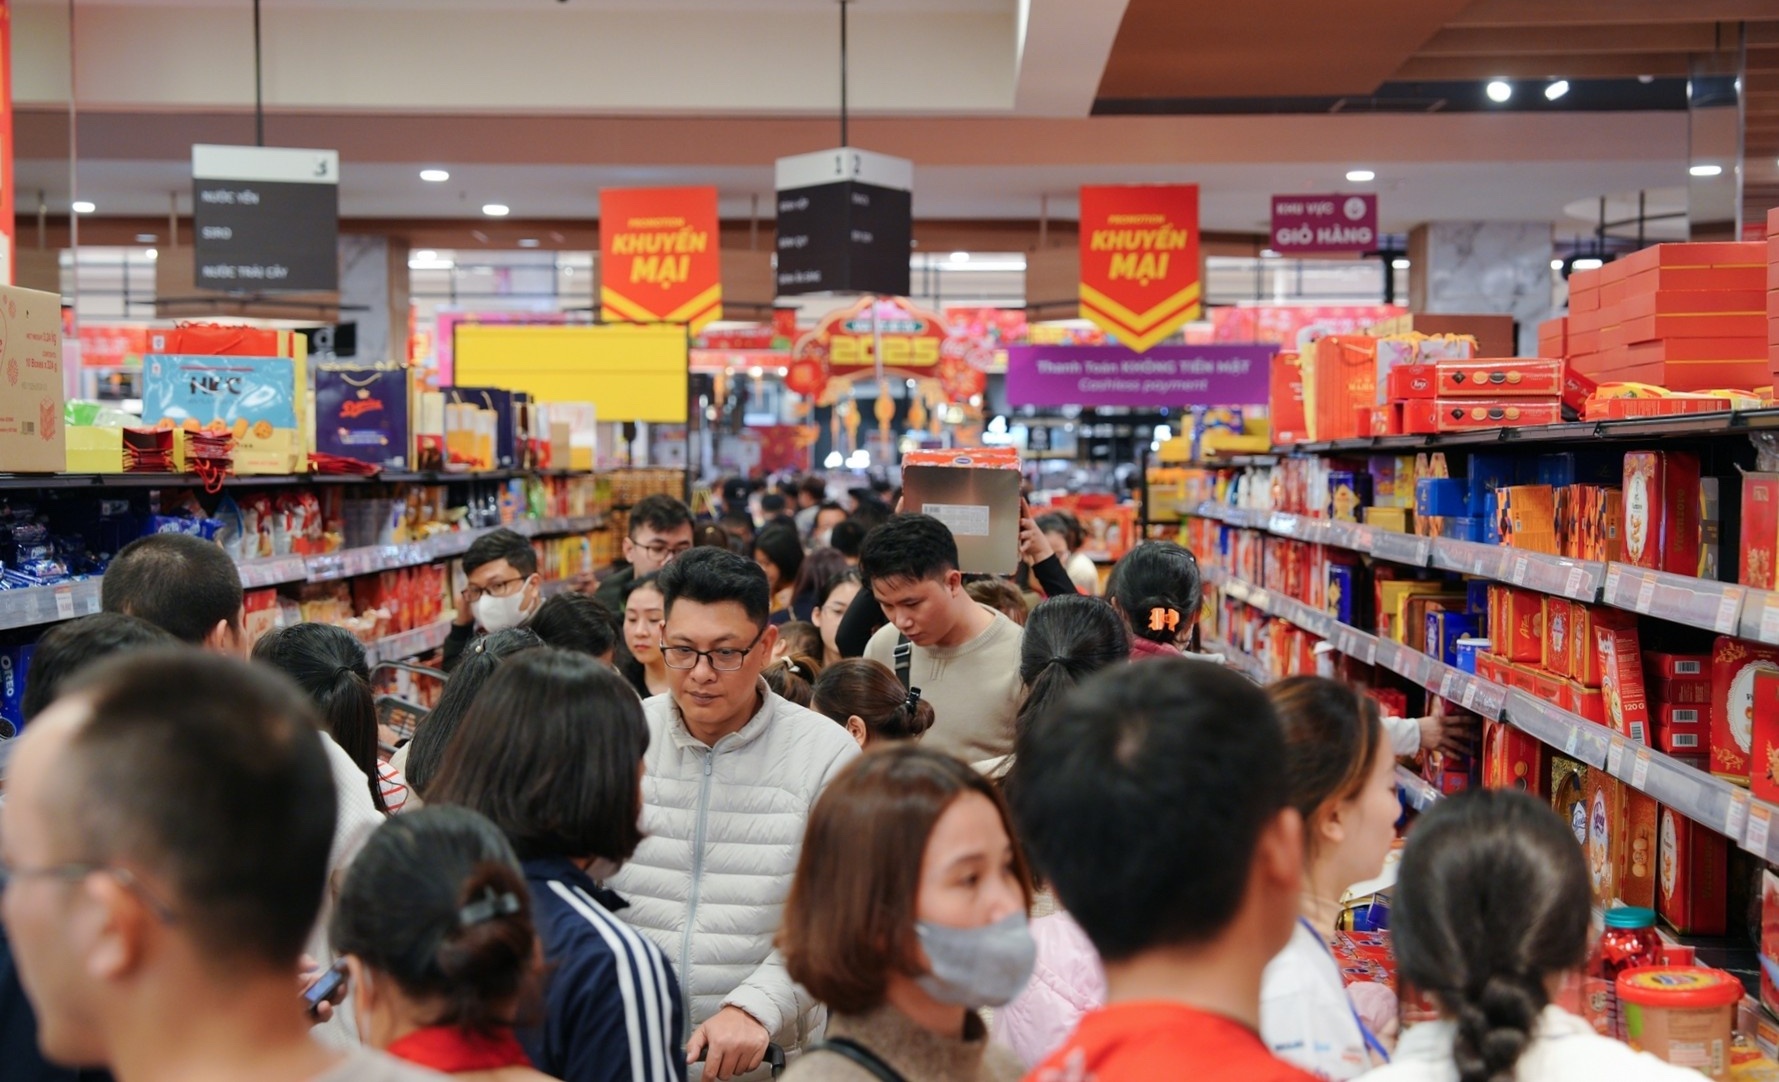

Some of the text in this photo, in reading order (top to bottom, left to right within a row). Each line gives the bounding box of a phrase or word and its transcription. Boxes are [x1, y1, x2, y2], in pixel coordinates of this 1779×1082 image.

[1276, 202, 1304, 215] KHU
[611, 224, 708, 255] KHUYẾN
[1090, 222, 1188, 251] KHUYẾN
[1276, 223, 1373, 244] GIỎ HÀNG
[629, 255, 690, 290] MẠI
[1108, 252, 1170, 287] MẠI
[829, 335, 940, 366] 2025
[1036, 360, 1081, 374] Thanh
[1121, 358, 1176, 374] KHÔNG
[1078, 377, 1208, 394] Cashless payment
[1, 655, 15, 697] OREO
[1624, 702, 1645, 711] 120 G
